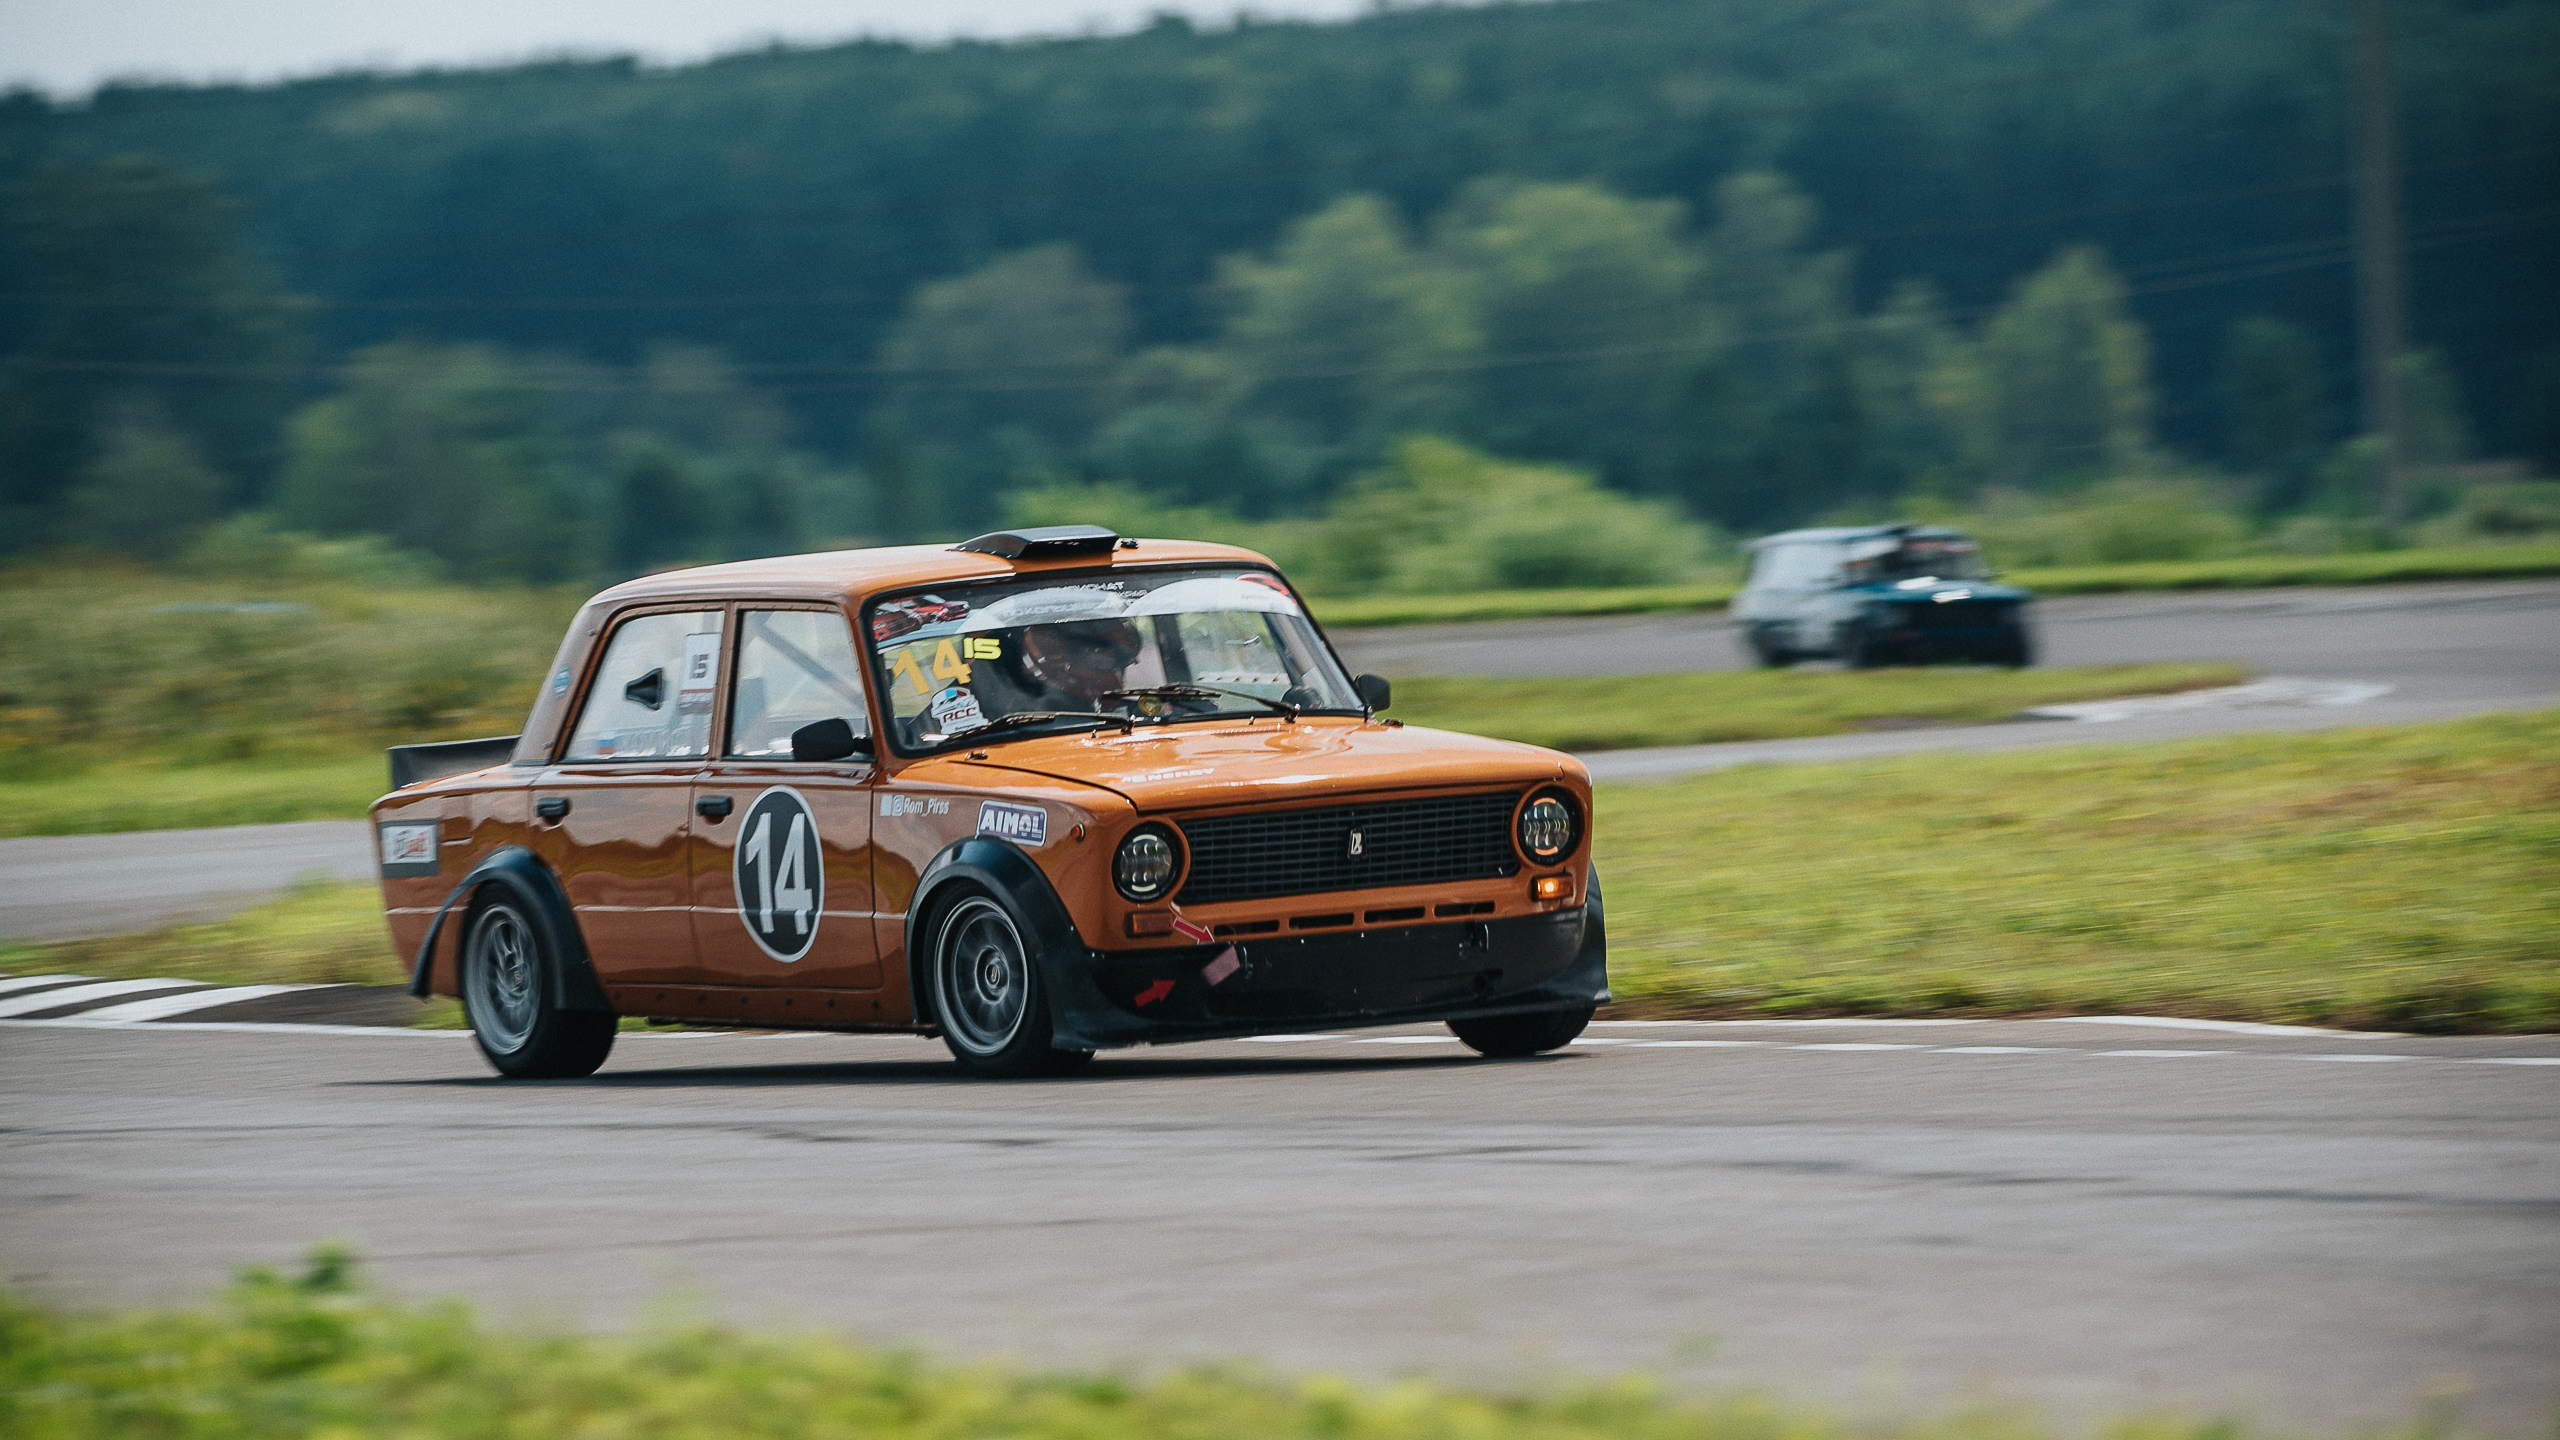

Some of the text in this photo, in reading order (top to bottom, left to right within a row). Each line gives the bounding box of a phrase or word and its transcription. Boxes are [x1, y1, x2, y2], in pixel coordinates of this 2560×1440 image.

[891, 638, 972, 696] 14
[943, 706, 977, 723] RCC
[979, 808, 1043, 836] AIMOL
[745, 812, 814, 935] 14
